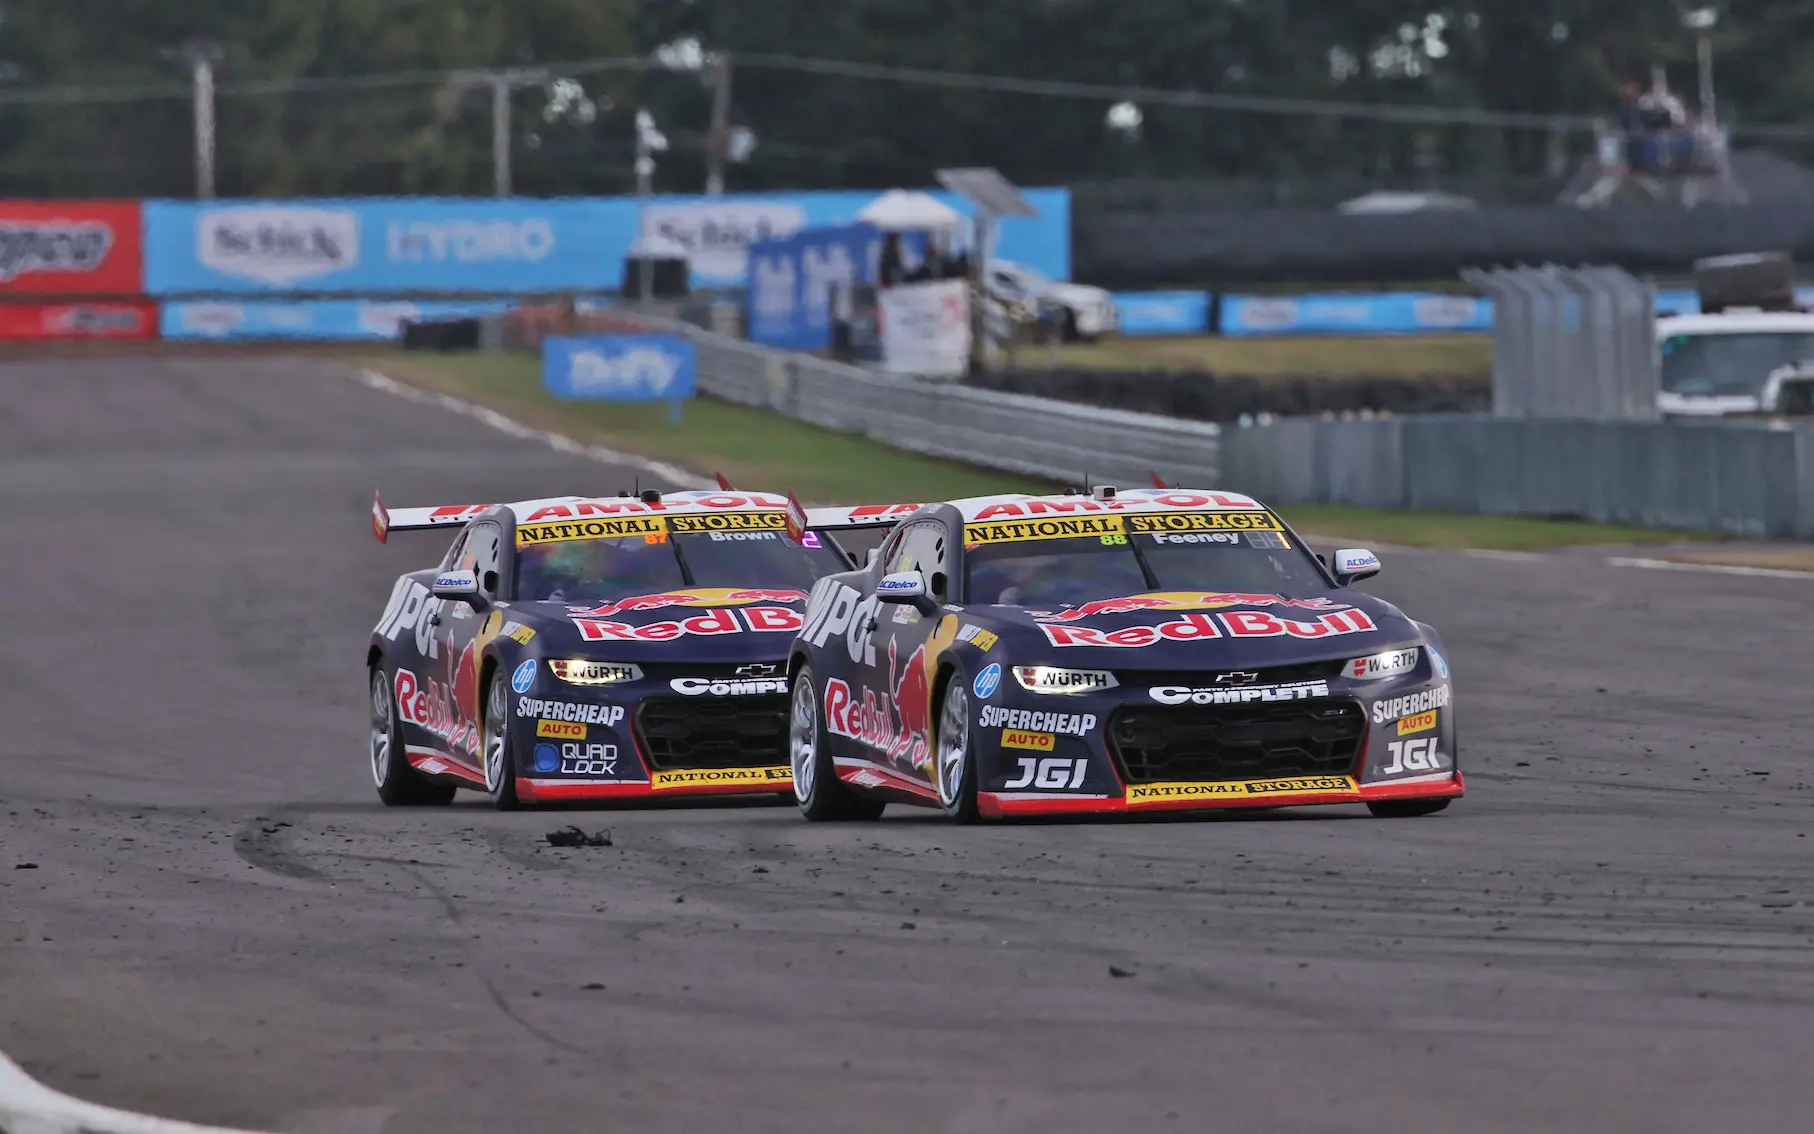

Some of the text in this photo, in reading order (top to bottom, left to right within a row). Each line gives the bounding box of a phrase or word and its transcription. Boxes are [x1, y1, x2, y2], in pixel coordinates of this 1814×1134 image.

[525, 496, 790, 521] AMPOL
[973, 495, 1255, 520] AMPOL
[518, 519, 660, 542] NATIONAL
[672, 513, 787, 531] STORAG
[708, 531, 777, 542] Brown
[966, 512, 1270, 542] NATIONAL STORAGE
[1151, 532, 1239, 545] Feeney
[1100, 534, 1129, 546] 88
[571, 608, 744, 642] Red
[1036, 613, 1223, 648] Red
[1215, 607, 1379, 639] Bull
[515, 661, 535, 691] hp
[670, 677, 788, 697] COMPL
[976, 665, 998, 697] hp
[1042, 671, 1107, 687] WÜRTH
[1149, 684, 1330, 705] COMPLETE
[516, 695, 625, 728] SUPERCHEAP
[825, 676, 871, 743] Red
[978, 704, 1097, 737] SUPERCHEAP
[542, 723, 583, 736] AUTO
[1401, 711, 1433, 732] AUTO
[562, 743, 618, 760] QUAD
[1006, 733, 1050, 747] AUTO
[560, 760, 617, 775] LOCK
[1383, 737, 1441, 776] JGI
[659, 770, 762, 784] NATIONAL
[1004, 757, 1088, 789] JGI
[1131, 777, 1349, 798] NATIONAL STORAGE
